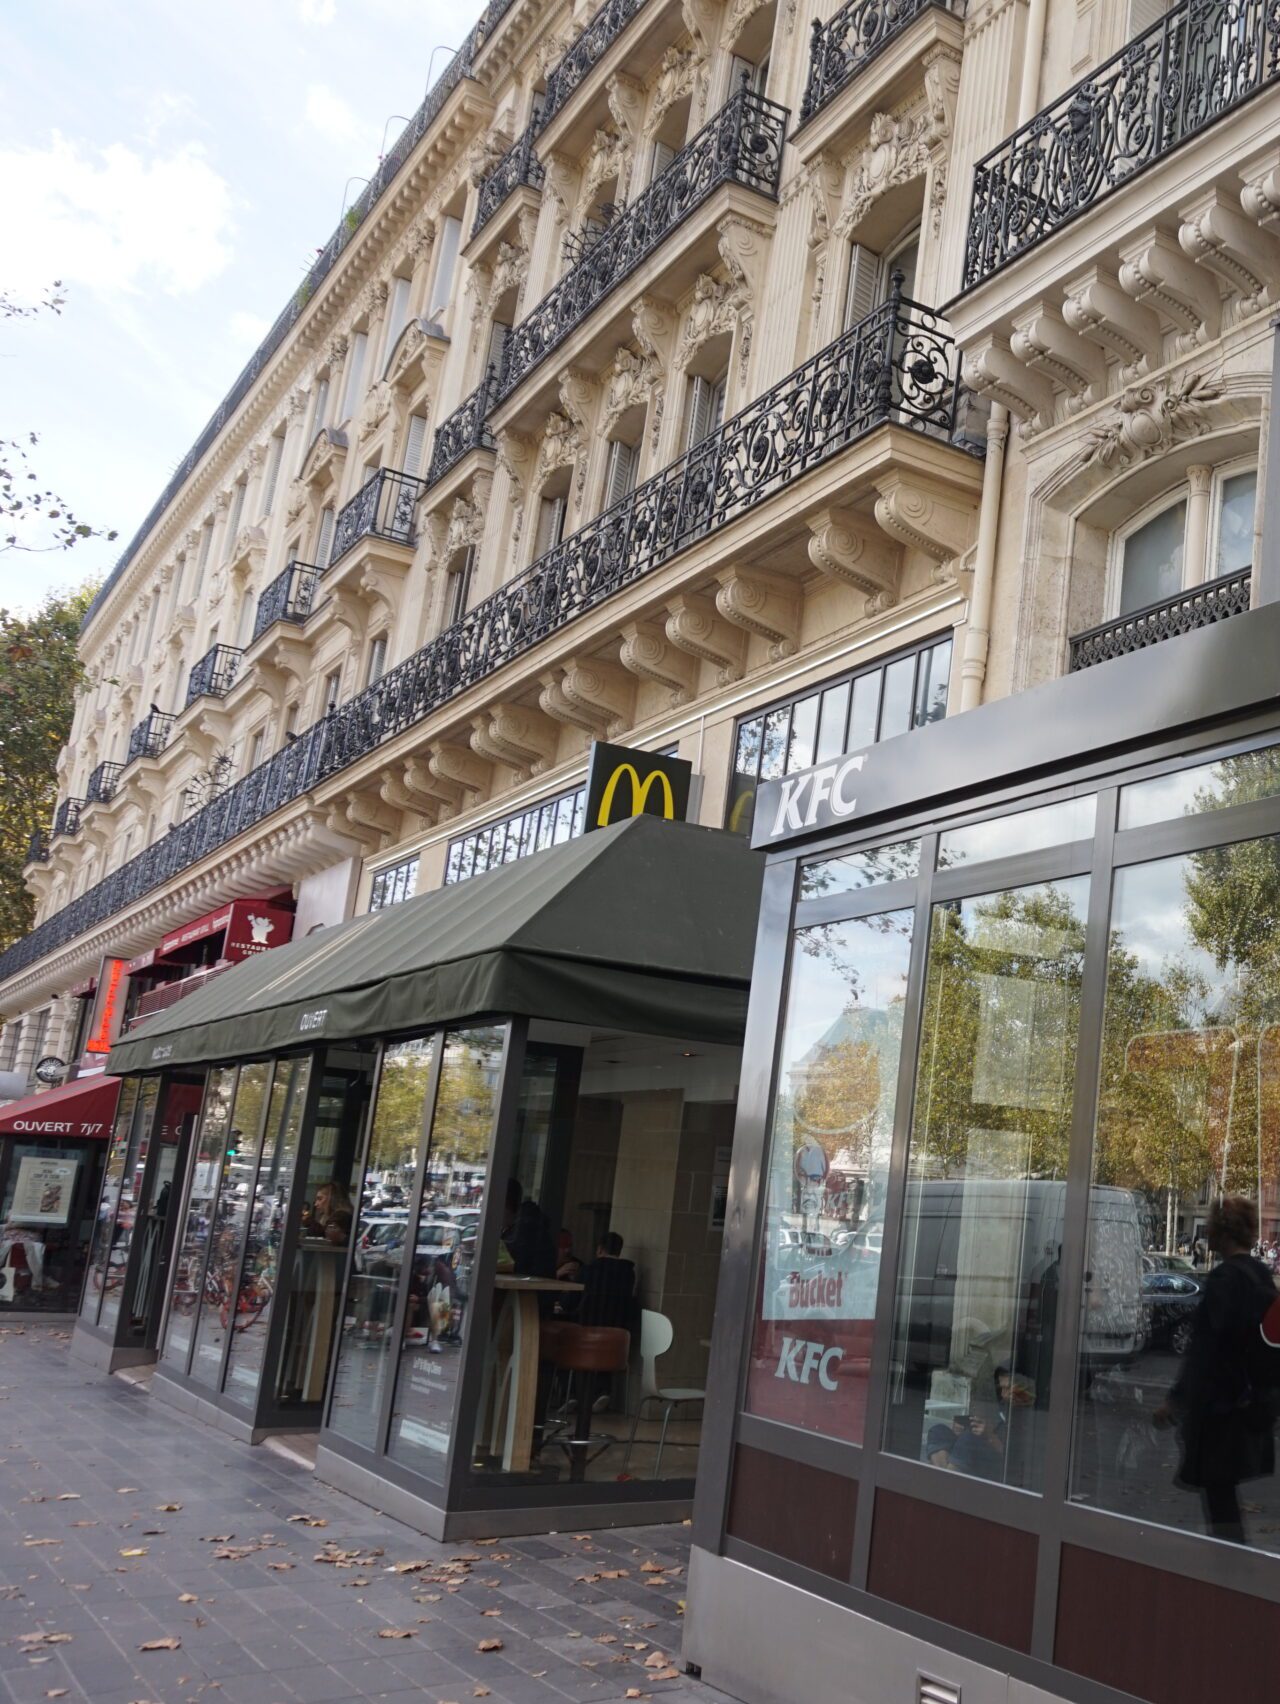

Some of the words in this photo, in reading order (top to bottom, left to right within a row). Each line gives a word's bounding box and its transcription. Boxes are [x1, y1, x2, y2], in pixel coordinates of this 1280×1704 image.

[770, 755, 864, 837] KFC
[13, 1120, 74, 1133] OUVERT
[788, 1270, 844, 1308] Bucket
[775, 1337, 844, 1391] KFC
